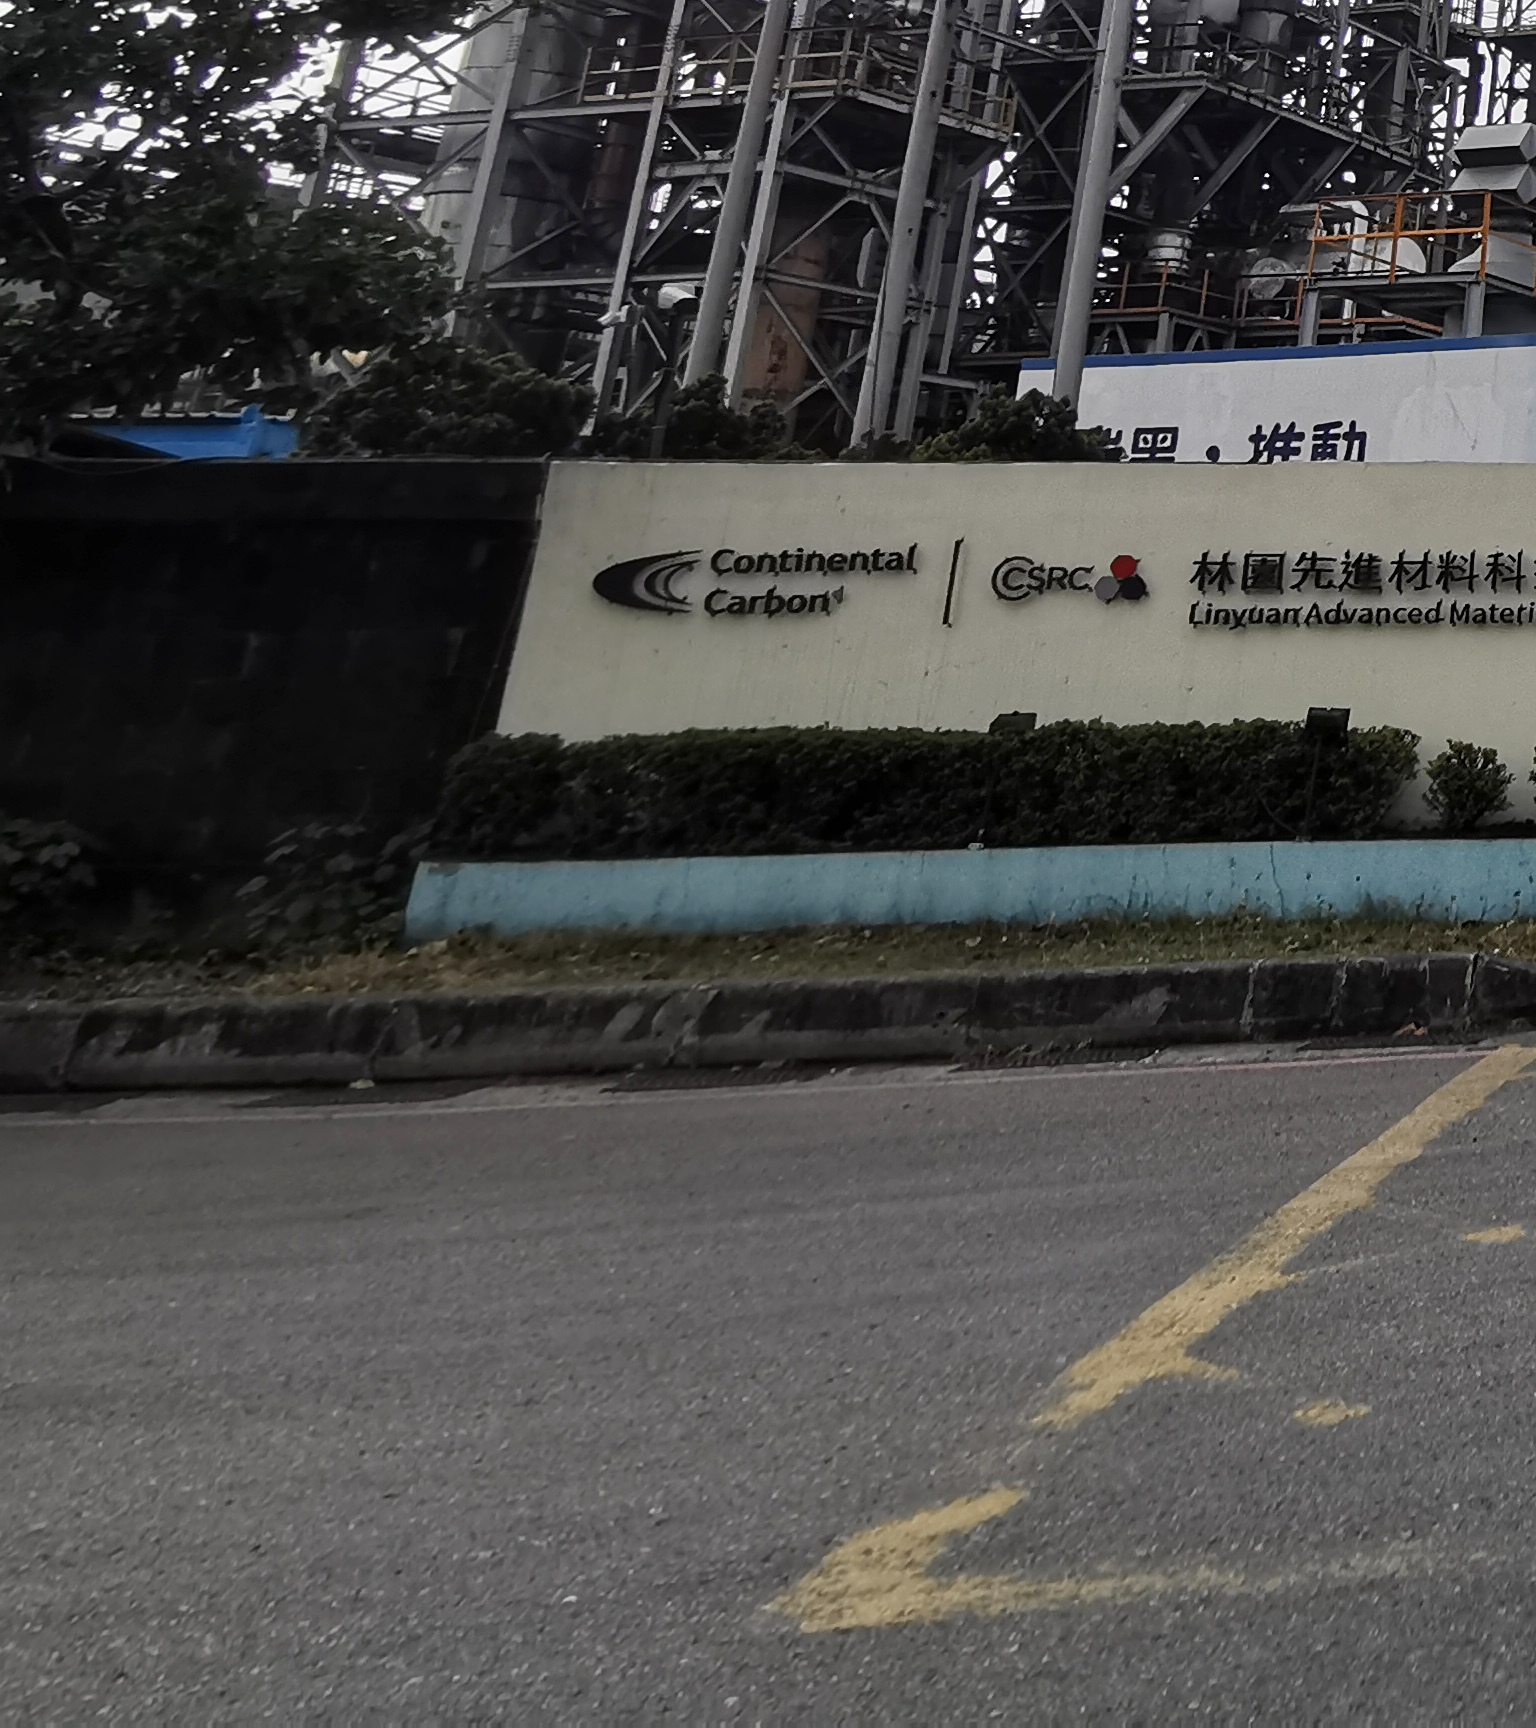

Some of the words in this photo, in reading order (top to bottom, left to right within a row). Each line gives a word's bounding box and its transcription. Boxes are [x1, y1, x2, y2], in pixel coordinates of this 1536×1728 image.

[710, 542, 918, 576] Continental
[704, 584, 832, 619] Carbon
[1189, 600, 1303, 630] Linyuan
[1303, 598, 1445, 628] Advanced
